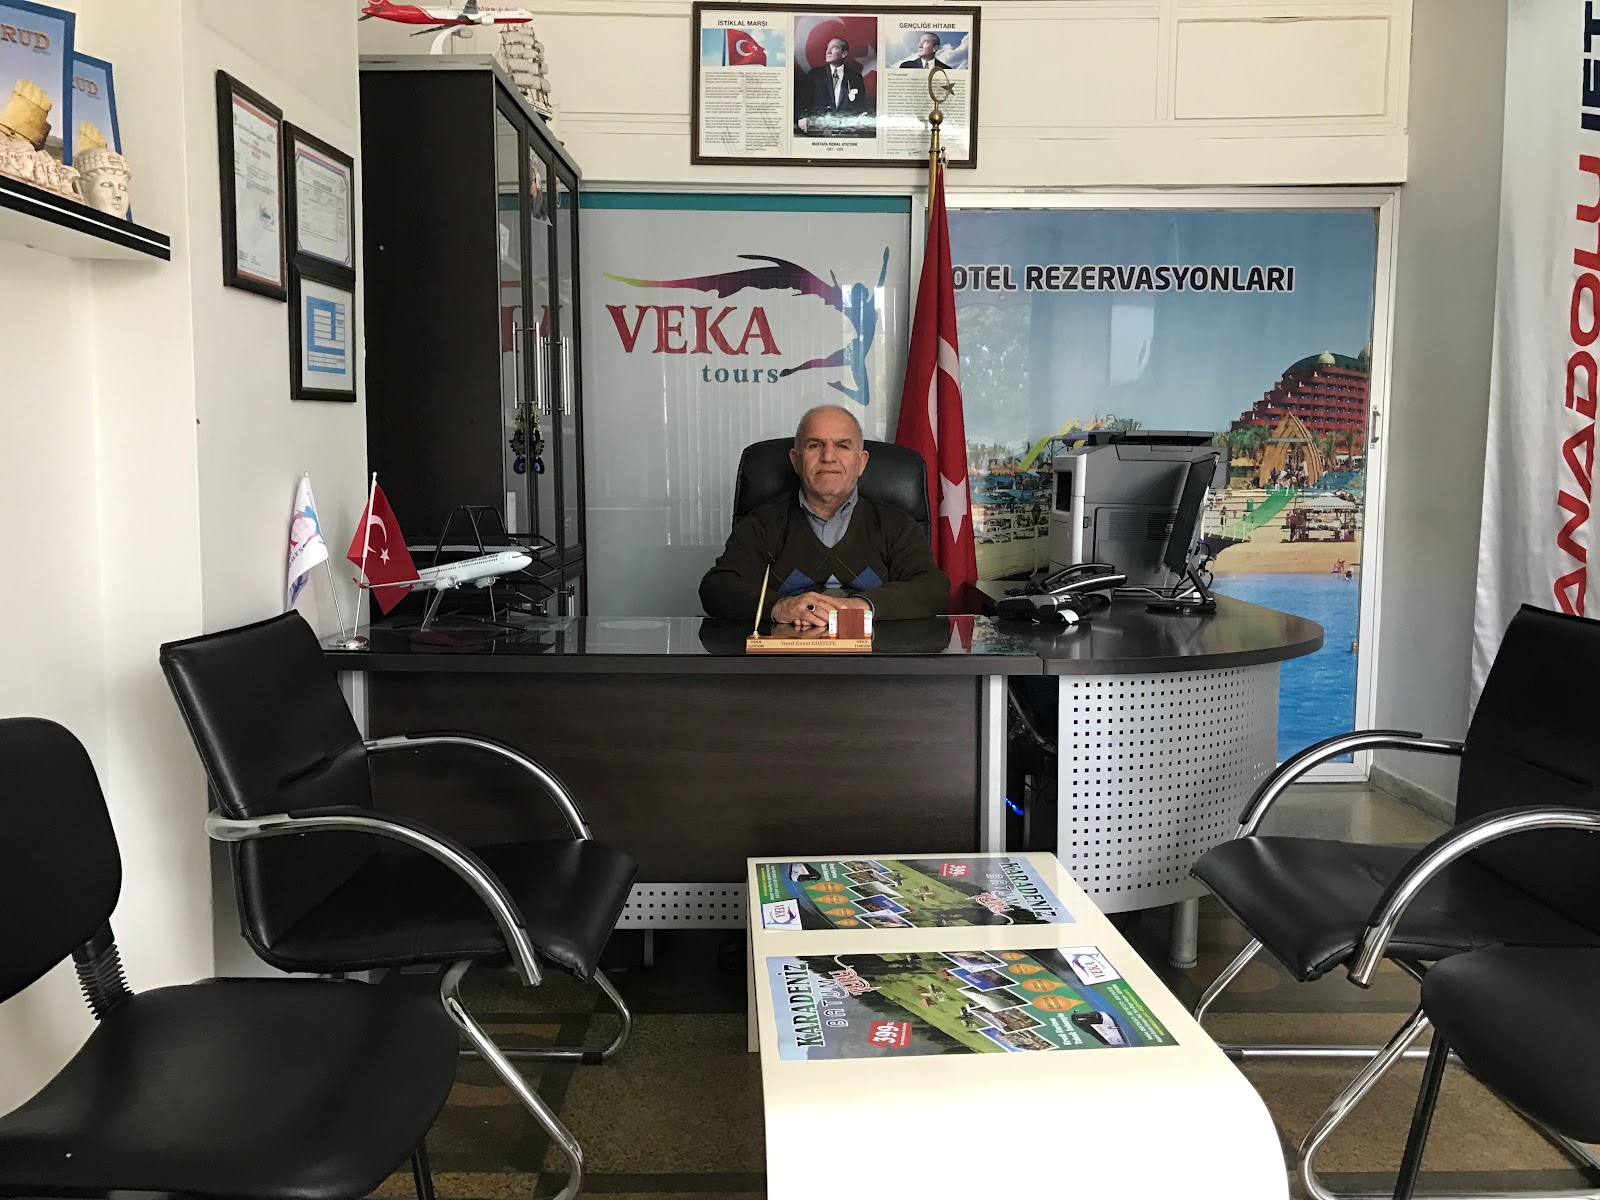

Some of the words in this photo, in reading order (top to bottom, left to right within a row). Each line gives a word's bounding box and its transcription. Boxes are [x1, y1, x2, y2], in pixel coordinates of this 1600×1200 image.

[717, 18, 744, 27] İSTİKLAL
[745, 19, 768, 27] MARŞI
[899, 21, 931, 30] GENÇLİĞE
[932, 22, 956, 30] HİTABE
[952, 265, 1017, 291] OTEL
[1025, 266, 1295, 291] REZERVASYONLARI
[605, 304, 782, 356] VEKA
[702, 364, 779, 384] tours
[949, 864, 967, 876] 399
[998, 862, 1059, 920] KARADENİZ
[773, 904, 786, 918] VEKA
[1084, 961, 1106, 979] VEKA
[776, 963, 826, 1047] KARADENİZ
[818, 978, 848, 1027] BATUM
[872, 1025, 899, 1044] 399
